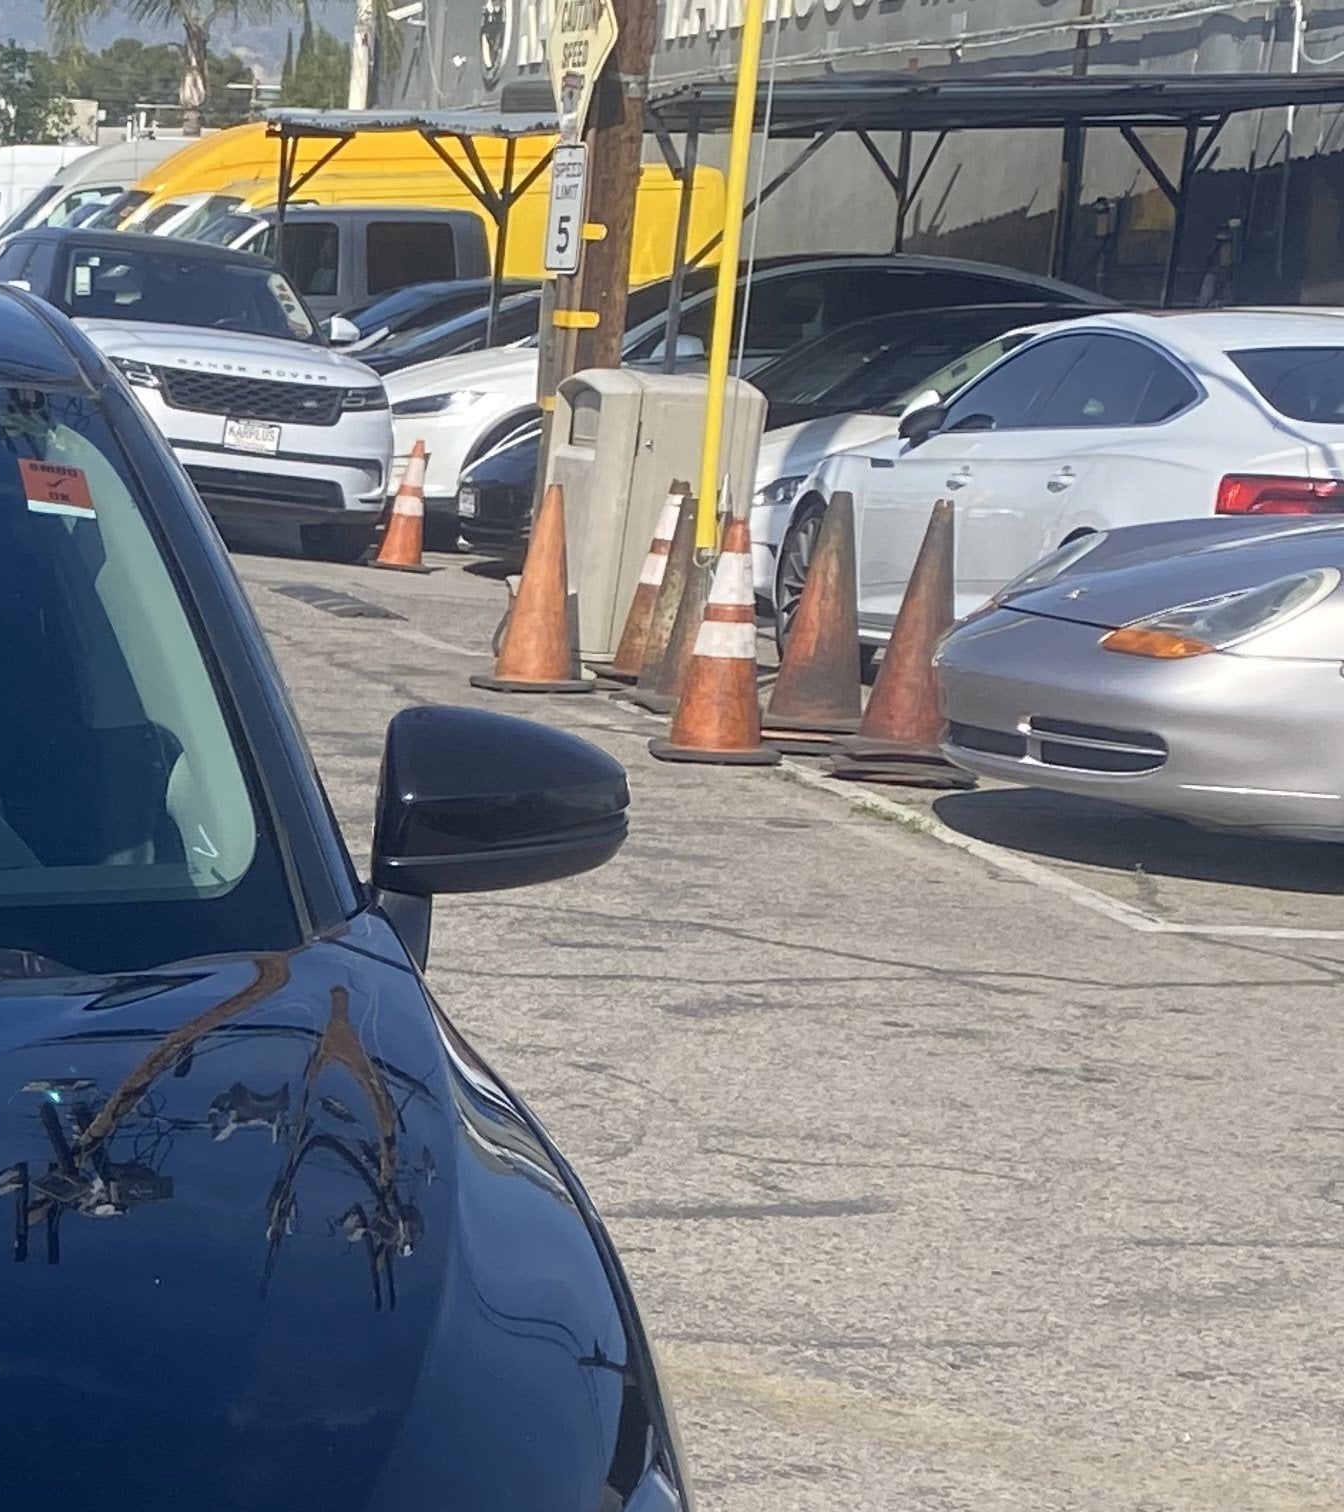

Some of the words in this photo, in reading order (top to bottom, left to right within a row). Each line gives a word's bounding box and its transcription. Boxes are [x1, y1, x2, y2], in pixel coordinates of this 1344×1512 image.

[561, 40, 589, 69] SPEED
[555, 161, 583, 178] SPEED
[555, 183, 580, 200] LIMIT
[555, 215, 572, 254] 5
[177, 358, 247, 372] RANGE
[262, 369, 327, 382] ROVER
[48, 491, 71, 503] OK
